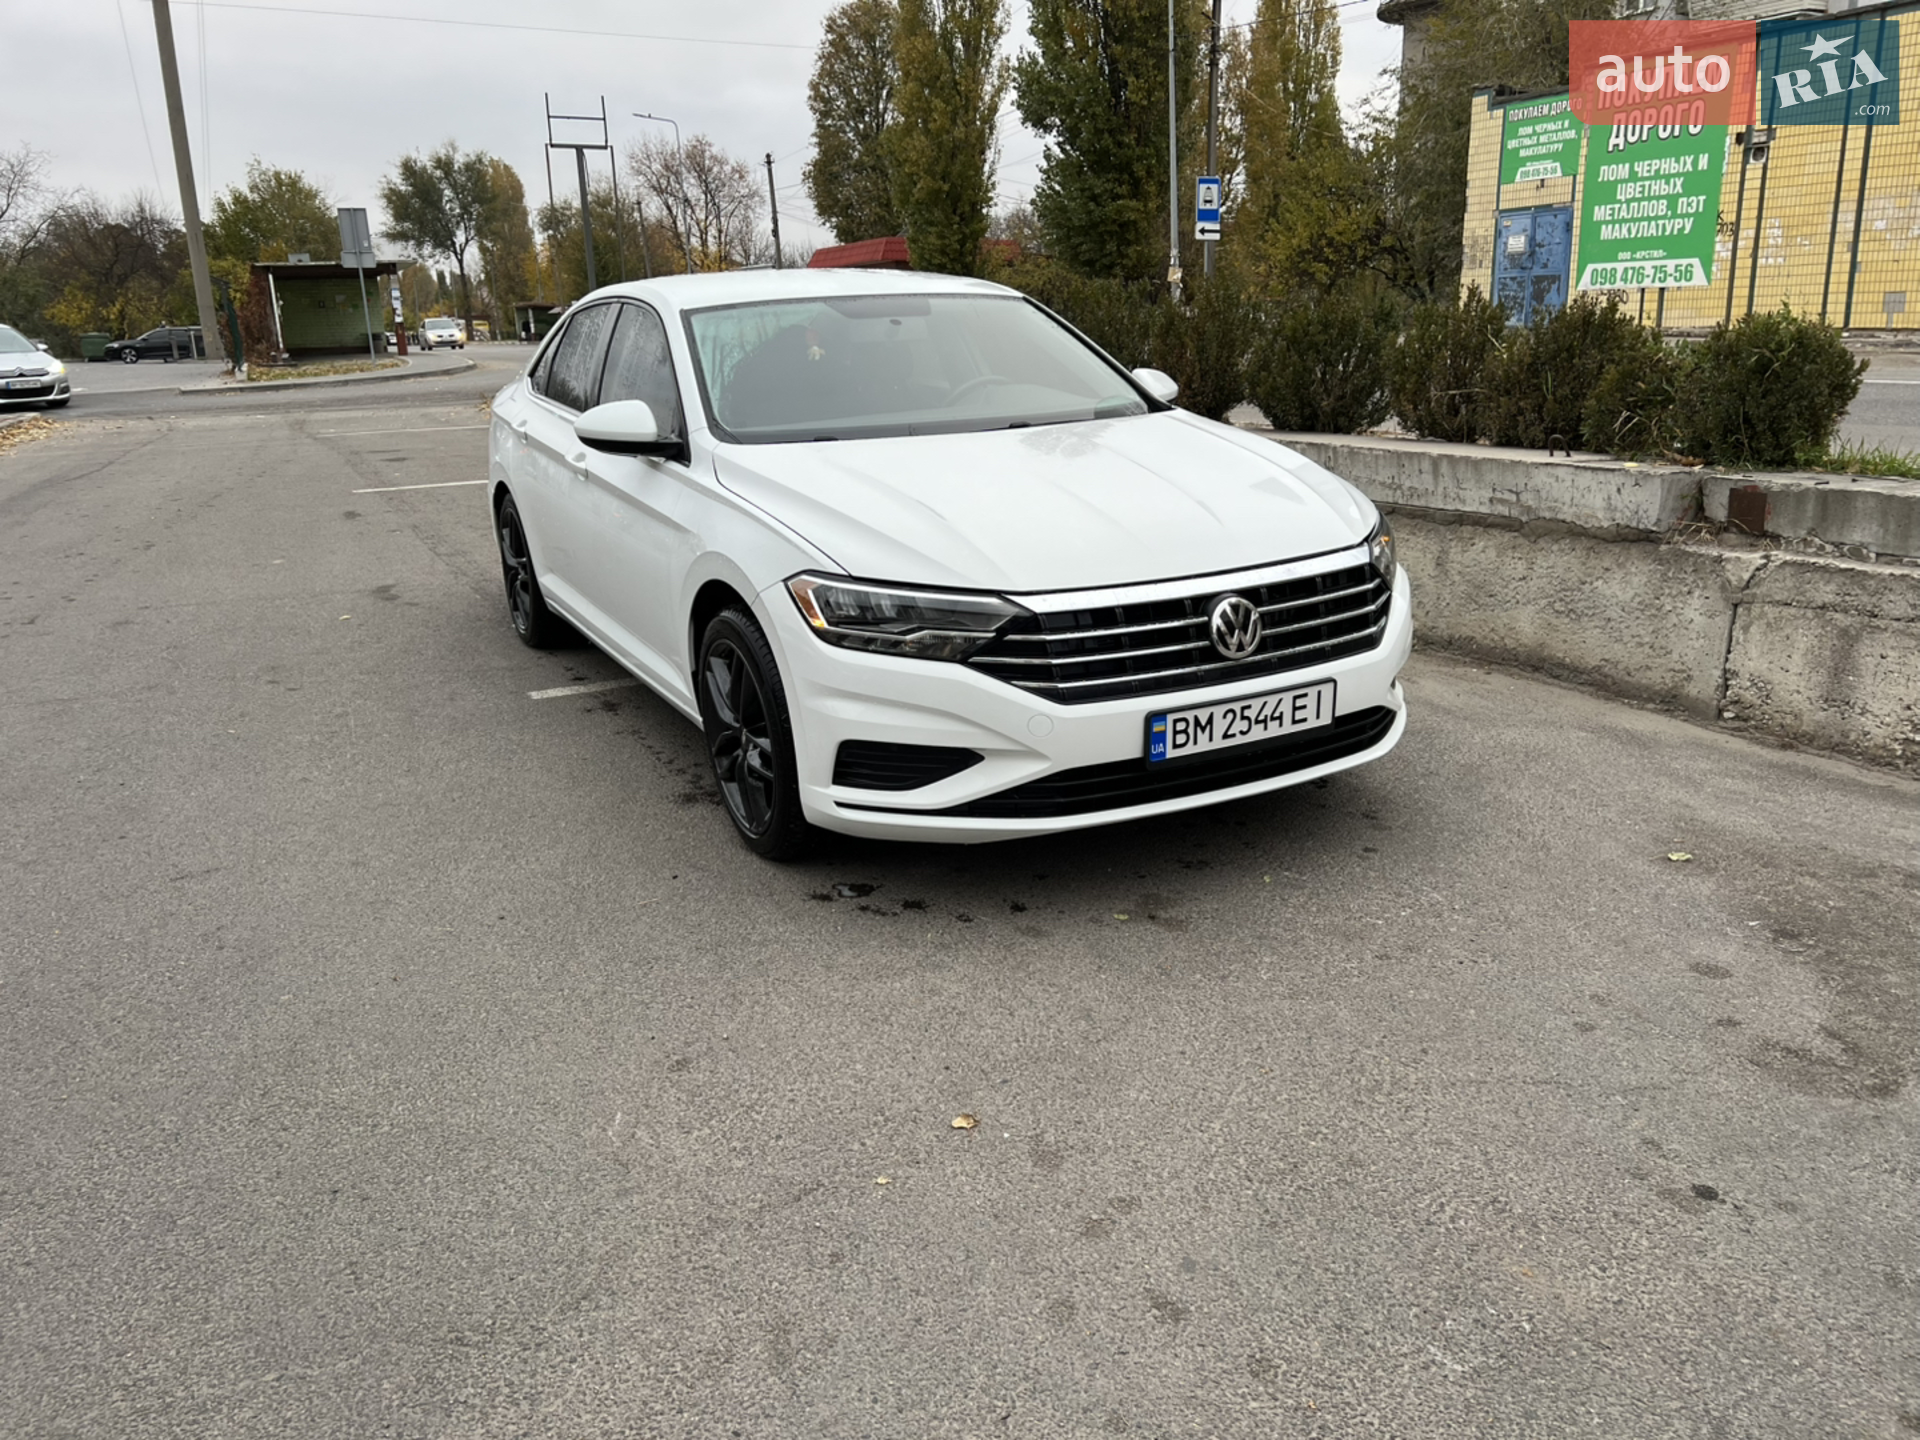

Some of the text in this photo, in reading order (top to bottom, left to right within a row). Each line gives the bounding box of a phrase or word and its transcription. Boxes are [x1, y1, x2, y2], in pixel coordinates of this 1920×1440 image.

[1509, 98, 1583, 122] ПОКУПАЕМ ДОРОГО
[1535, 120, 1563, 133] ЧЕРНЫХ
[1607, 98, 1706, 152] ДОРОГО
[1507, 135, 1537, 150] ЦВЕТНЫХ
[1519, 143, 1563, 157] МАКУЛАТУРУ
[1597, 153, 1709, 182] ЛОМ ЧЕРНЫХ И
[1616, 177, 1684, 202] ЦВЕТНЫХ
[1593, 195, 1706, 221] МЕТАЛЛОВ, ПЭТ
[1600, 217, 1694, 240] МАКУЛАТУРУ
[1590, 263, 1694, 286] 098 476-75-56
[1172, 690, 1321, 750] BM 2544 EI
[1151, 743, 1165, 754] UA
